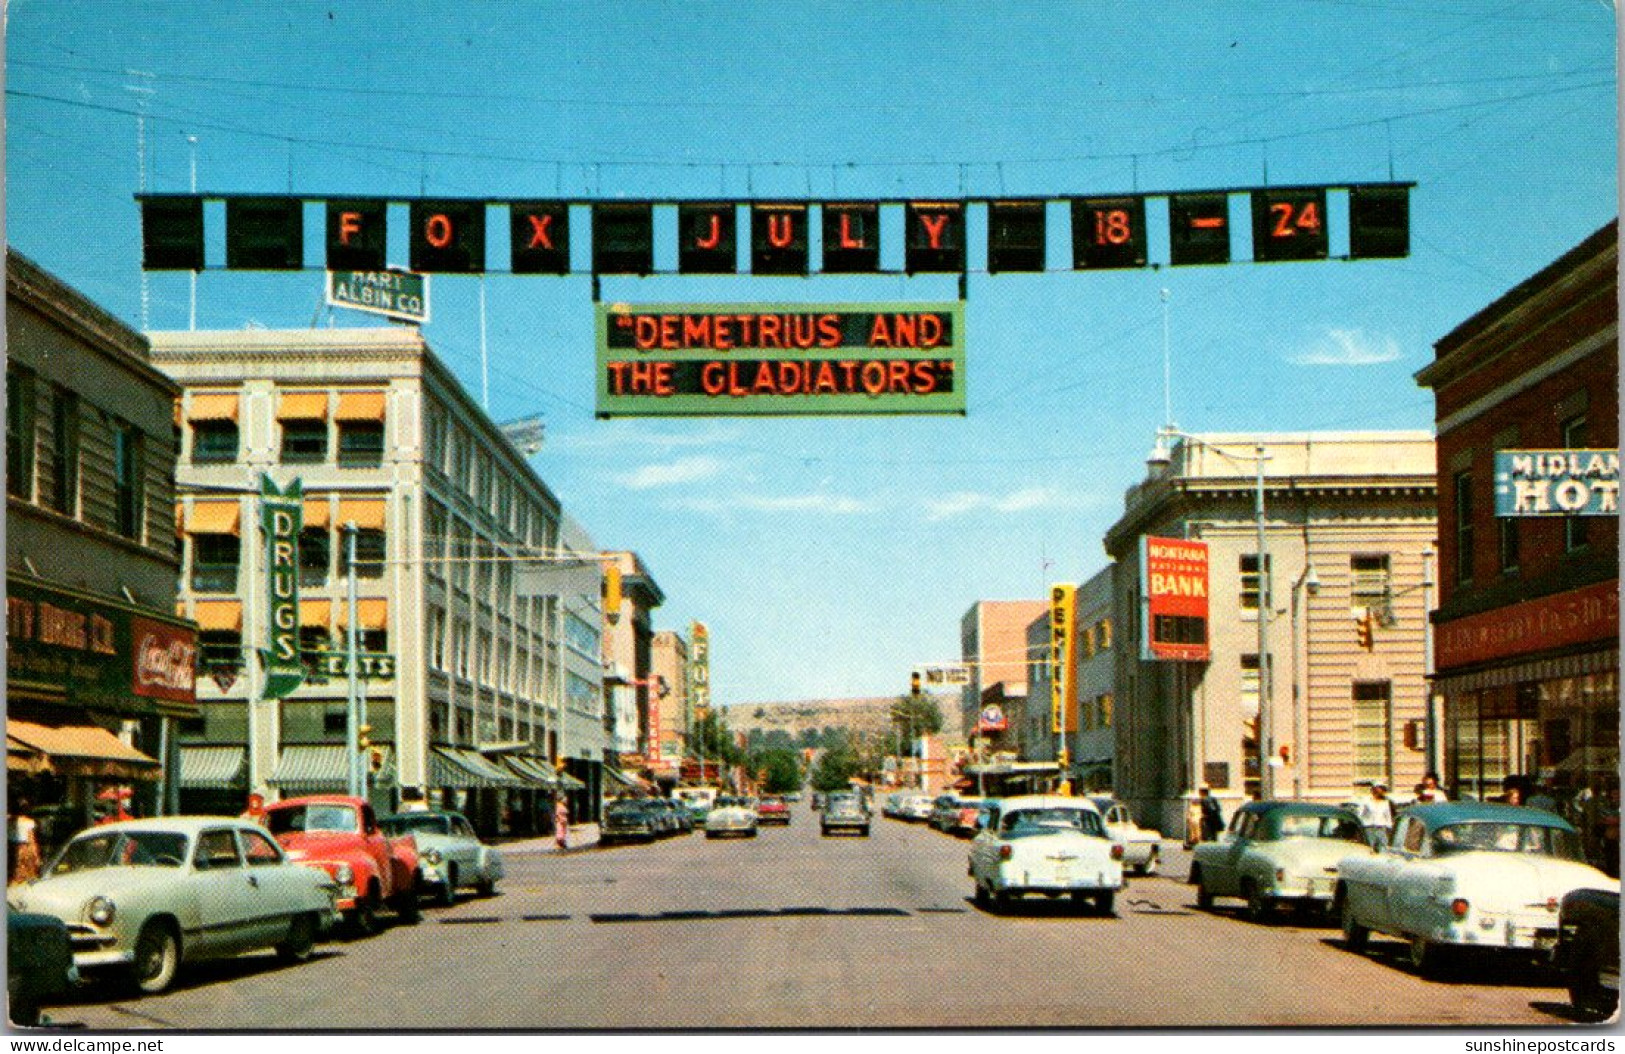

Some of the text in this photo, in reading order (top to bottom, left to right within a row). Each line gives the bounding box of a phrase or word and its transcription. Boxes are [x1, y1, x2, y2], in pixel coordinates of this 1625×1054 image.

[339, 211, 552, 249] FOX
[697, 213, 949, 249] JULY
[1094, 211, 1132, 245] 18
[1270, 202, 1321, 237] 24
[336, 282, 393, 308] ALBIN
[869, 314, 945, 350] AND
[608, 361, 673, 396] THE
[1149, 545, 1206, 560] MONTANA
[273, 510, 296, 661] DRUGS
[1151, 573, 1206, 597] BANK
[693, 645, 709, 706] FOX
